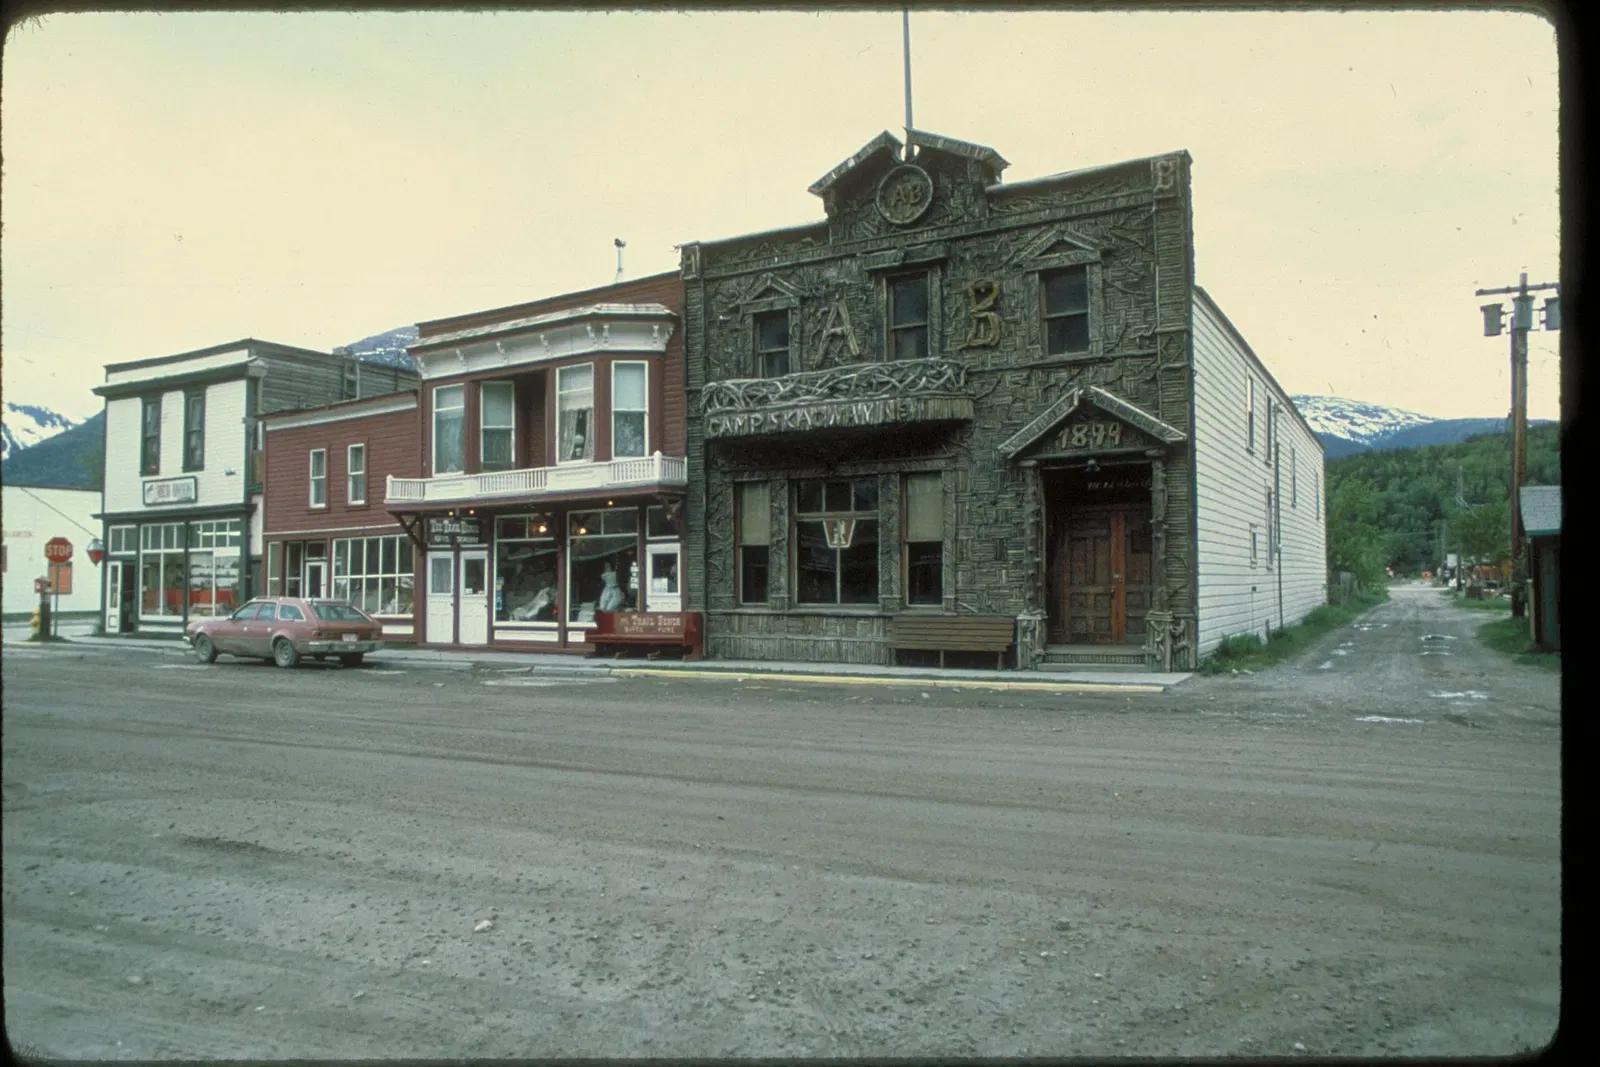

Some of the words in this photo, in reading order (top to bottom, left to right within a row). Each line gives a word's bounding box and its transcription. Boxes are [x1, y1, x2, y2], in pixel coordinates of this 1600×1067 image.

[813, 294, 861, 369] A
[960, 279, 1001, 351] B
[708, 412, 764, 438] CAMP
[768, 401, 874, 432] SKAGWAY
[1059, 422, 1122, 450] 1899
[48, 545, 72, 556] STOP
